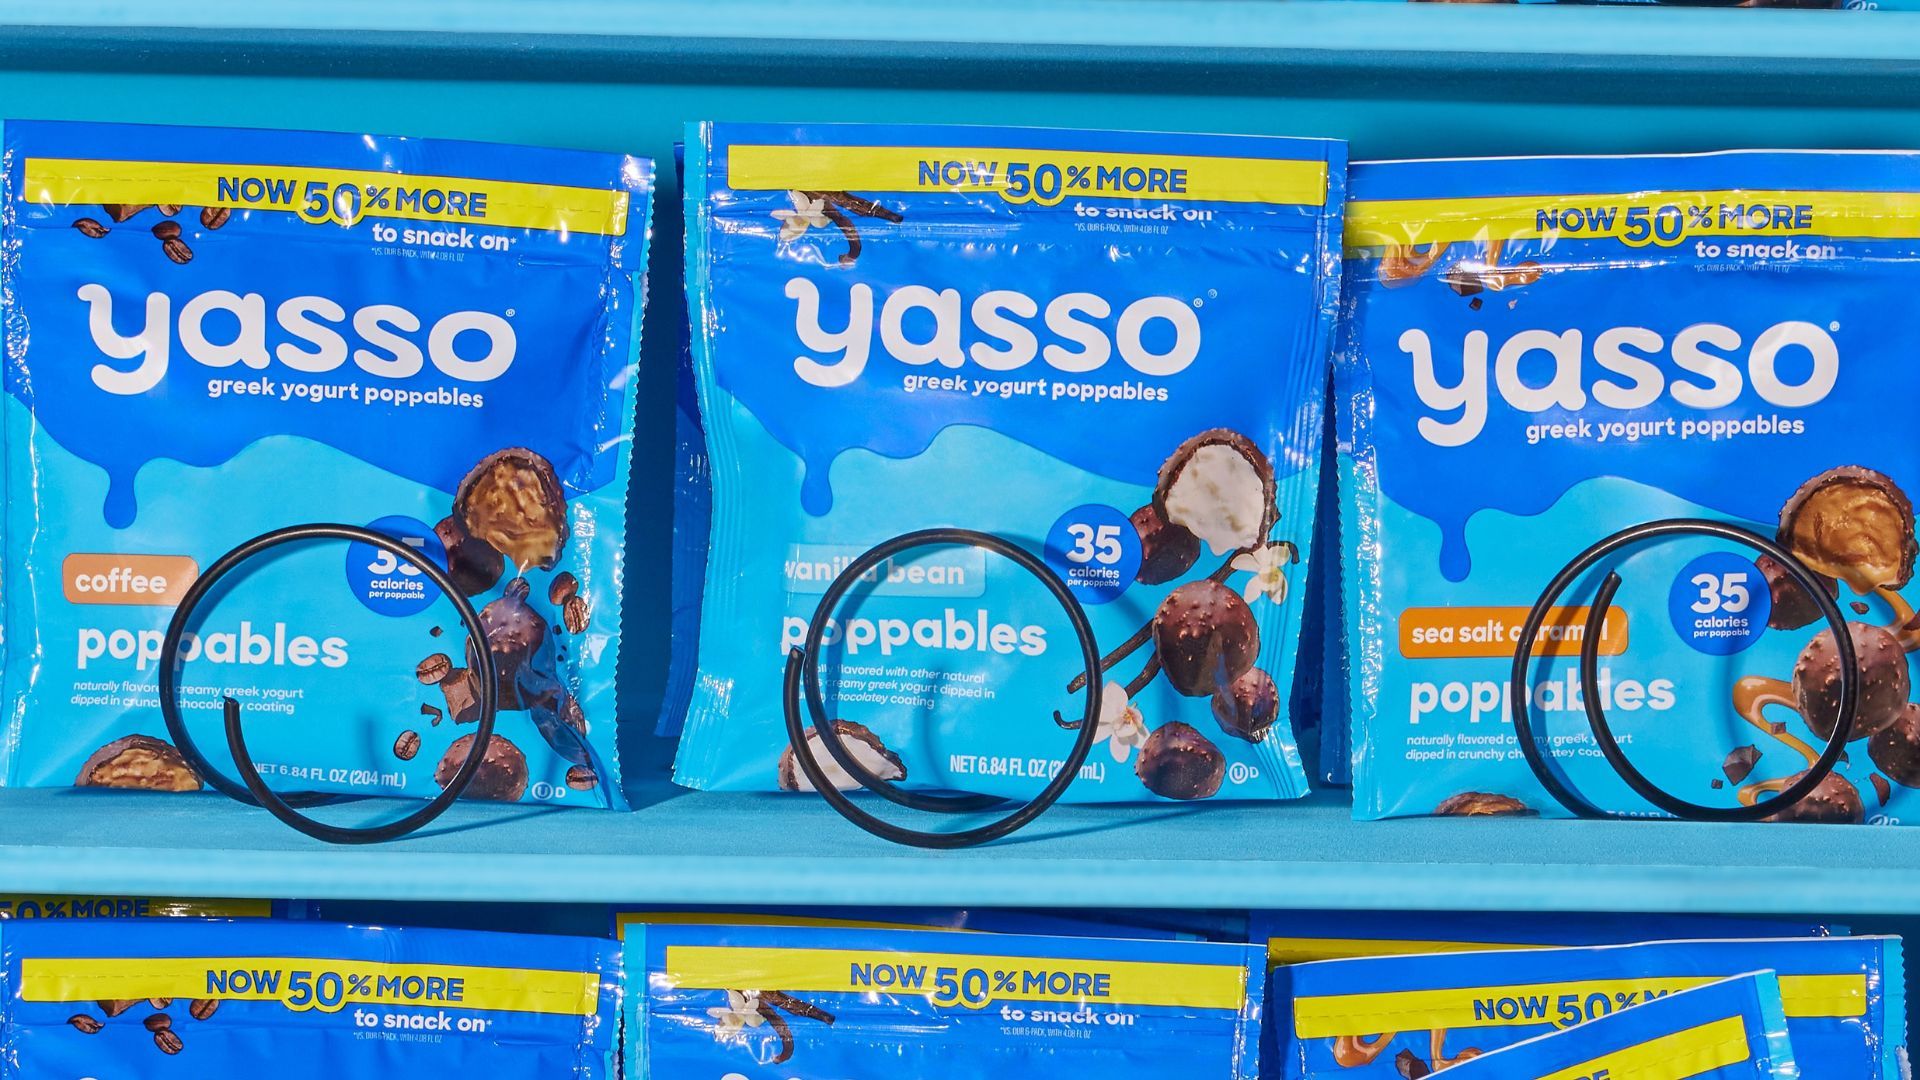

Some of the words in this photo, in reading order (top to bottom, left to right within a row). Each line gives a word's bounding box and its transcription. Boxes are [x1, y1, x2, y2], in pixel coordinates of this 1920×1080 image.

[918, 161, 998, 186] NOW
[1005, 162, 1090, 199] 50%
[1096, 166, 1188, 193] MORE
[218, 177, 296, 204] NOW
[302, 181, 390, 219] 50%
[396, 186, 487, 217] MORE
[1074, 202, 1100, 217] to
[1105, 203, 1177, 221] snack
[1536, 207, 1618, 232] NOW
[1624, 206, 1712, 242] 50%
[1718, 204, 1813, 229] MORE
[372, 223, 398, 243] to
[402, 225, 473, 249] snack
[1695, 240, 1721, 258] to
[1727, 240, 1800, 260] snack
[208, 377, 275, 397] greek
[280, 382, 358, 402] yogurt
[365, 386, 484, 408] poppables
[903, 374, 967, 393] greek
[971, 378, 1047, 400] yogurt
[1051, 380, 1169, 403] poppables
[1525, 418, 1591, 444] greek
[1597, 416, 1676, 442] yogurt
[1681, 414, 1805, 442] poppables
[1066, 523, 1122, 564] 35
[75, 567, 167, 594] coffee
[887, 557, 964, 584] bean
[1069, 566, 1120, 579] calories
[368, 590, 384, 598] per
[384, 590, 425, 600] poppable
[370, 578, 424, 591] calories
[1084, 579, 1120, 588] poppable
[1690, 573, 1750, 614] 35
[1412, 624, 1453, 644] sea
[1459, 619, 1503, 643] salt
[1509, 618, 1608, 642] craml
[1694, 629, 1709, 638] per
[1709, 628, 1750, 638] poppable
[1695, 616, 1748, 628] calories
[885, 665, 908, 676] with
[910, 667, 940, 680] other
[942, 671, 985, 684] natural
[73, 681, 120, 693] naturally
[122, 681, 167, 694] flavore
[223, 686, 259, 699] greek
[262, 687, 304, 700] yogurt
[868, 679, 898, 692] greek
[900, 682, 938, 695] yogurt
[940, 685, 982, 699] dipped
[984, 687, 995, 699] in
[70, 694, 108, 707] dipped
[110, 695, 120, 706] in
[246, 701, 295, 715] coating
[890, 694, 935, 710] coating
[1407, 733, 1452, 747] naturally
[1457, 733, 1504, 745] flavored
[1554, 733, 1588, 747] greek
[1406, 748, 1444, 762] dipped
[1446, 748, 1456, 760] in
[1458, 748, 1505, 762] crunchy
[252, 762, 278, 774] NET
[280, 765, 308, 779] 6.84
[310, 768, 326, 781] FL
[329, 768, 348, 783] OZ
[350, 769, 378, 786] (204
[381, 772, 406, 789] mL)
[950, 755, 976, 774] NET
[978, 756, 1007, 776] 6.84
[1009, 757, 1026, 777] FL
[1028, 759, 1047, 777] OZ
[1079, 762, 1105, 784] mL)
[72, 899, 149, 917] MORE
[206, 968, 281, 995] NOW
[289, 970, 371, 1006] 50%
[376, 973, 464, 1001] MORE
[850, 962, 928, 989] NOW
[934, 967, 1016, 1003] 50%
[1022, 970, 1111, 998] MORE
[354, 1008, 378, 1027] to
[384, 1011, 452, 1031] snack
[1000, 1005, 1025, 1021] to
[1031, 1007, 1100, 1025] snack
[1473, 995, 1549, 1021] NOW
